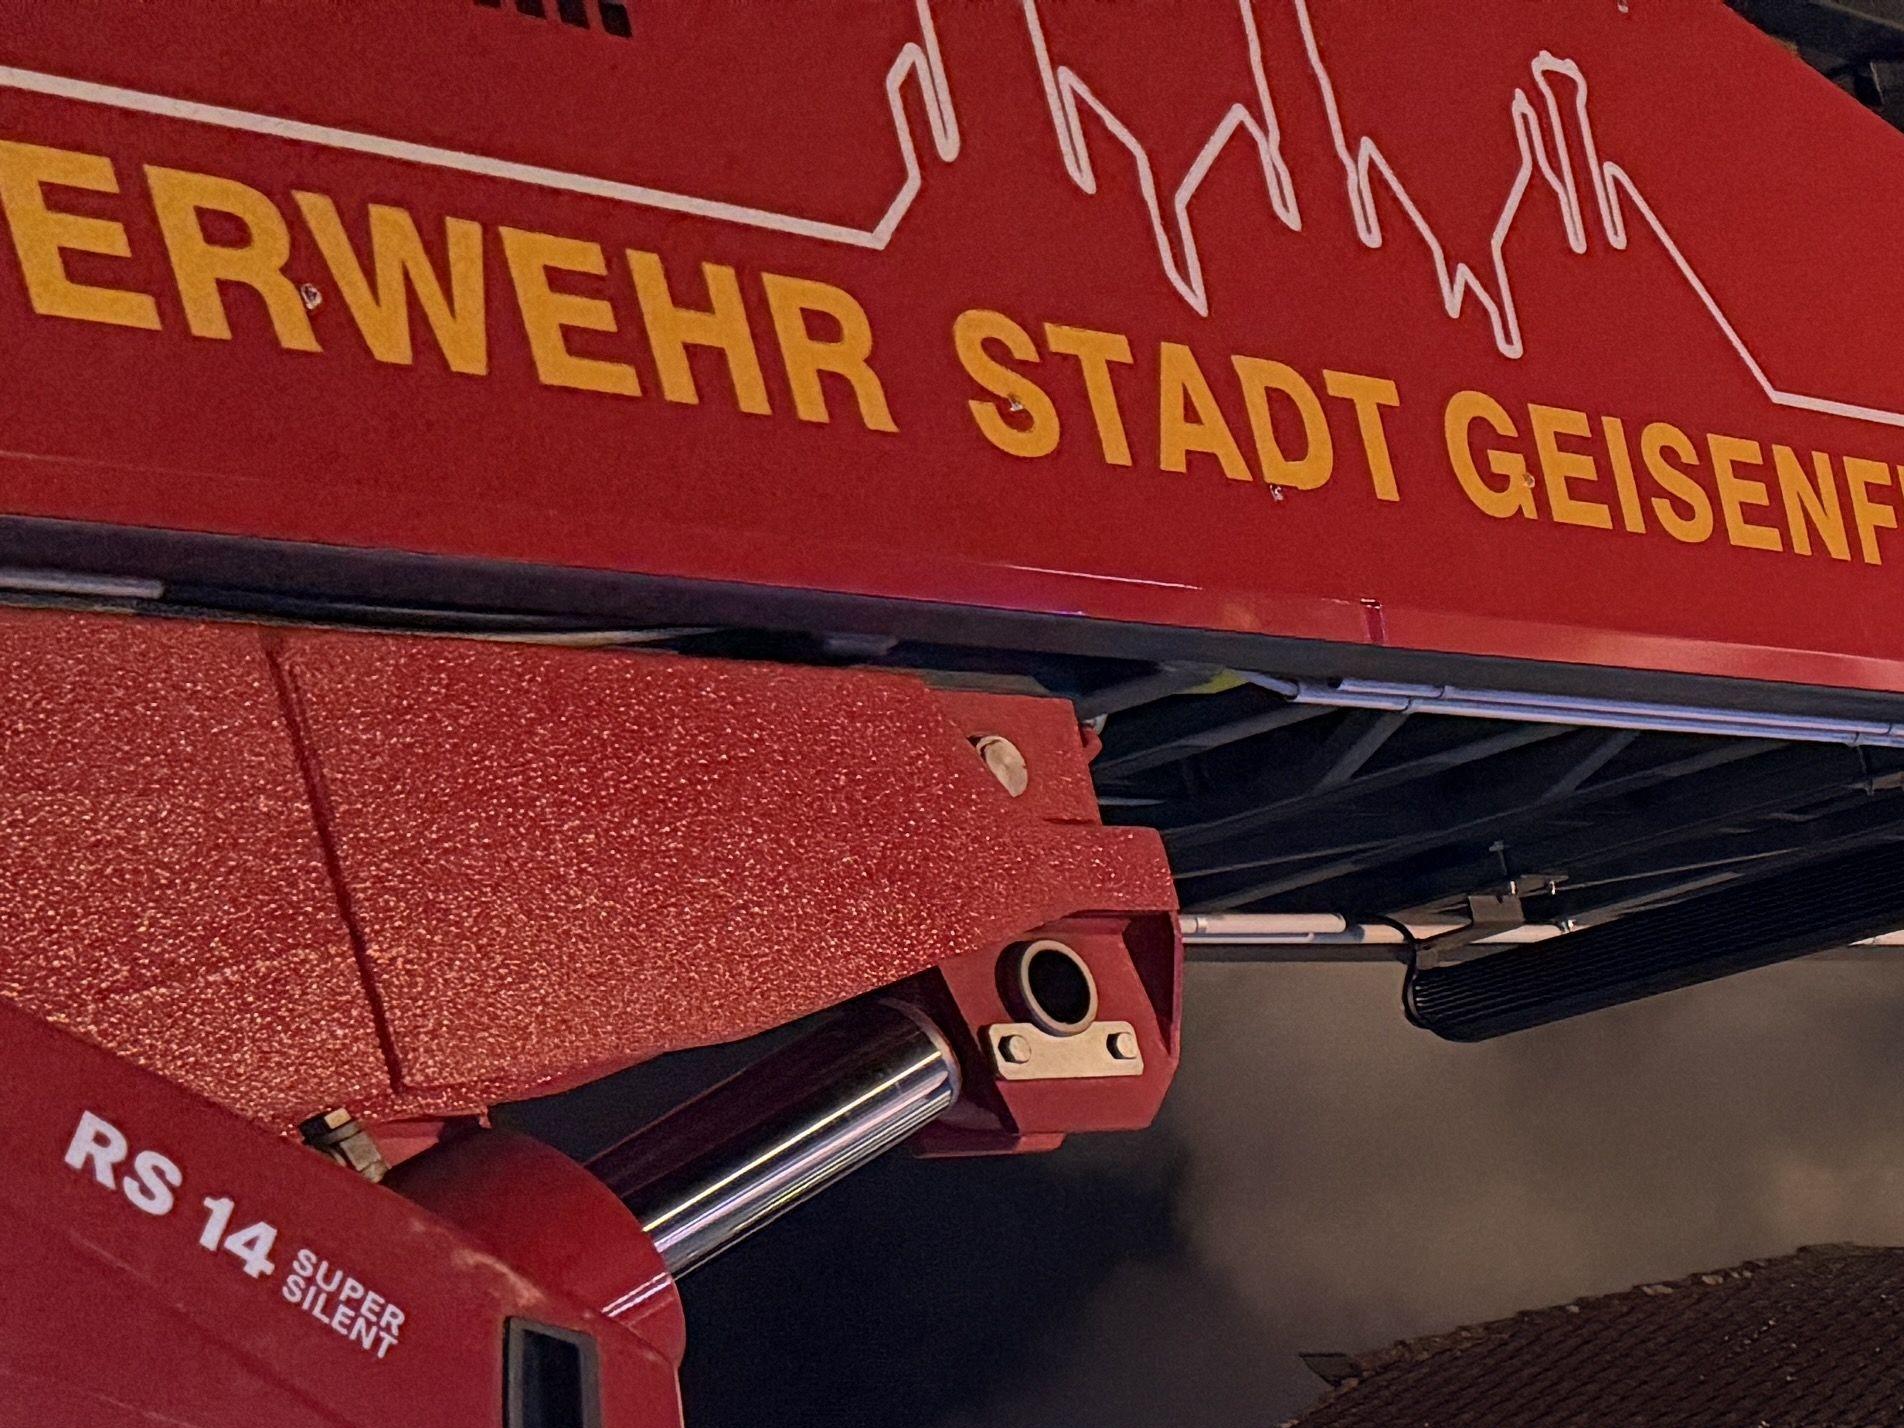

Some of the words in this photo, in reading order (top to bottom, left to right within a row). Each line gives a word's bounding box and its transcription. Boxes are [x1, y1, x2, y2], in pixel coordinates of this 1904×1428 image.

[0, 140, 899, 433] ERWEHR
[953, 308, 1400, 502] STADT
[64, 1110, 183, 1216] RS
[200, 1197, 278, 1279] 14
[281, 1274, 399, 1359] SILENT
[292, 1248, 406, 1337] SUPER
